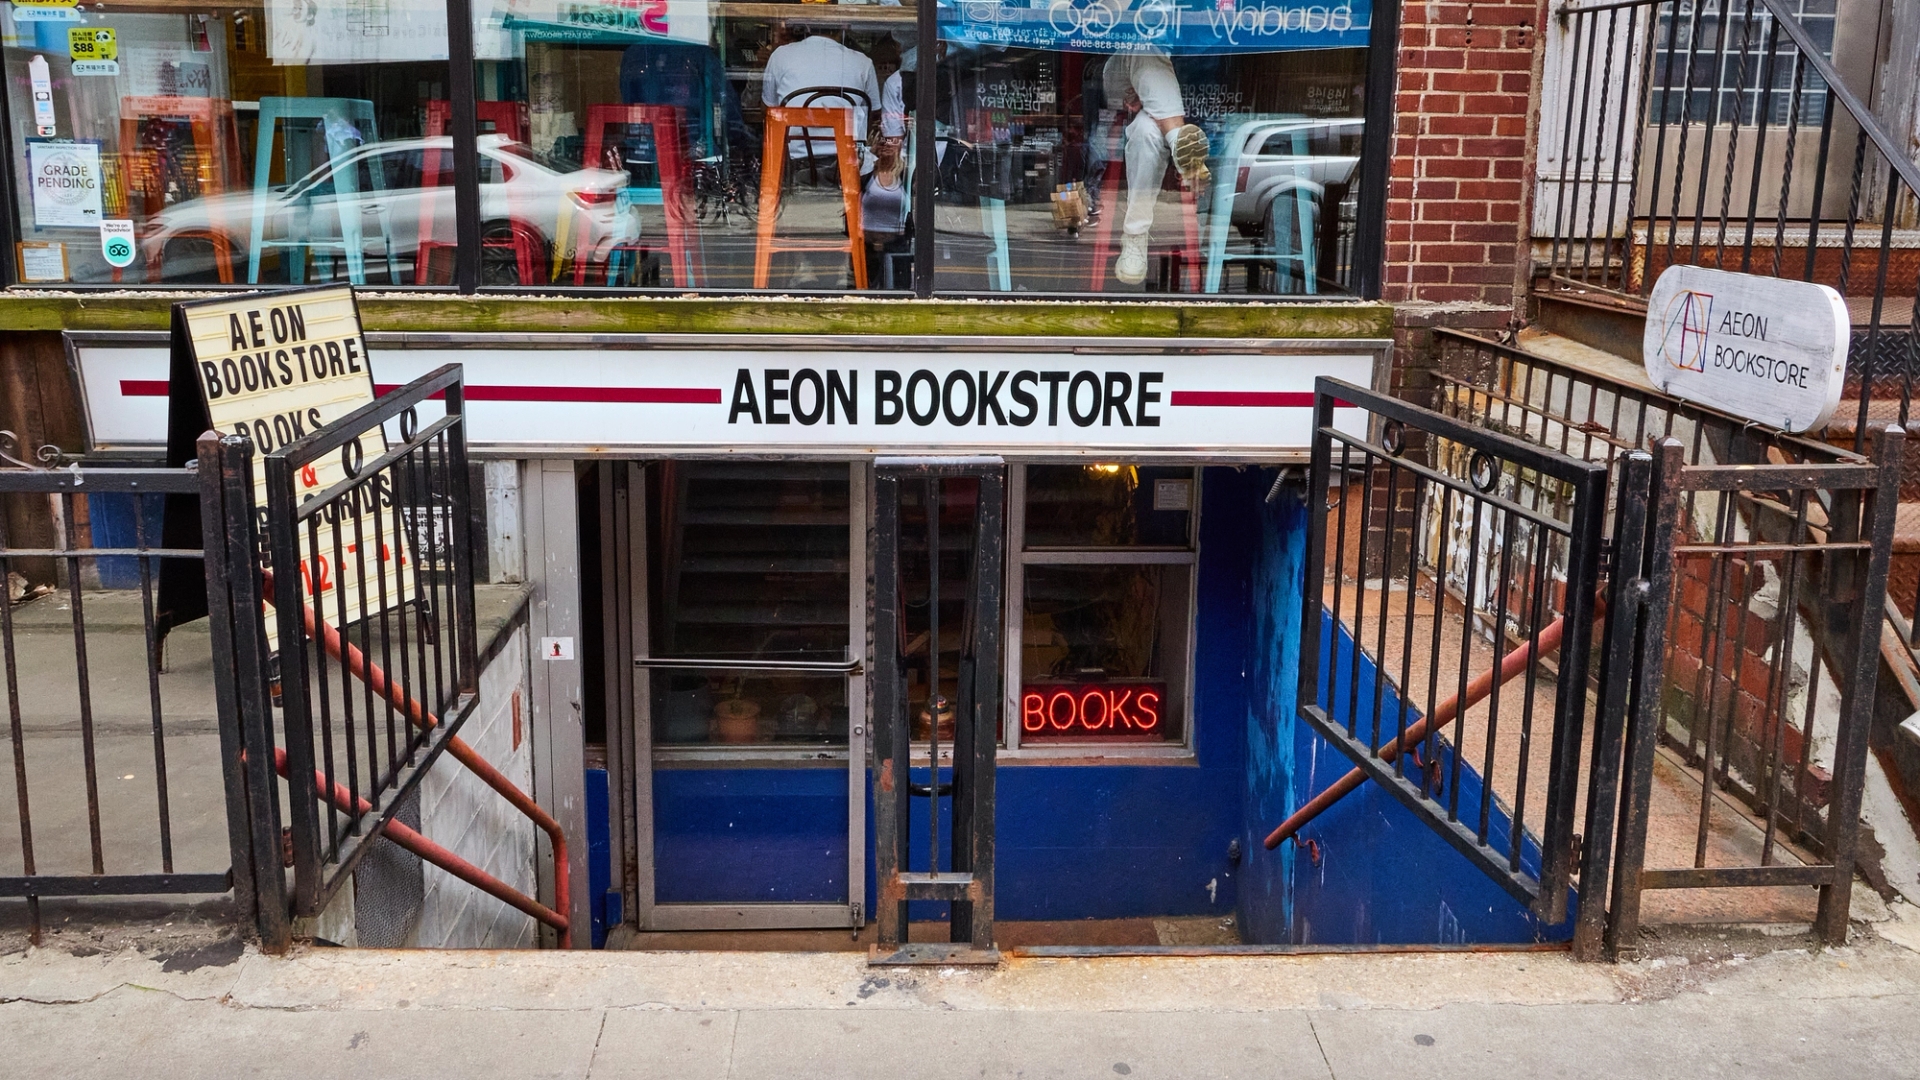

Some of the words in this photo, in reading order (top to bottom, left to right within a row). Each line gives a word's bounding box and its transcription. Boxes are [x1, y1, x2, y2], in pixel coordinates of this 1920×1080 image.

[73, 42, 94, 53] $88
[37, 177, 95, 189] PENDING
[43, 164, 88, 177] GRADE
[229, 305, 306, 351] AEON
[1718, 310, 1769, 341] AEON
[202, 338, 363, 399] BOOKSTORE
[1714, 344, 1810, 389] BOOKSTORE
[728, 368, 858, 425] AEON
[874, 369, 1164, 427] BOOKSTORE
[1024, 690, 1159, 731] BOOKS
